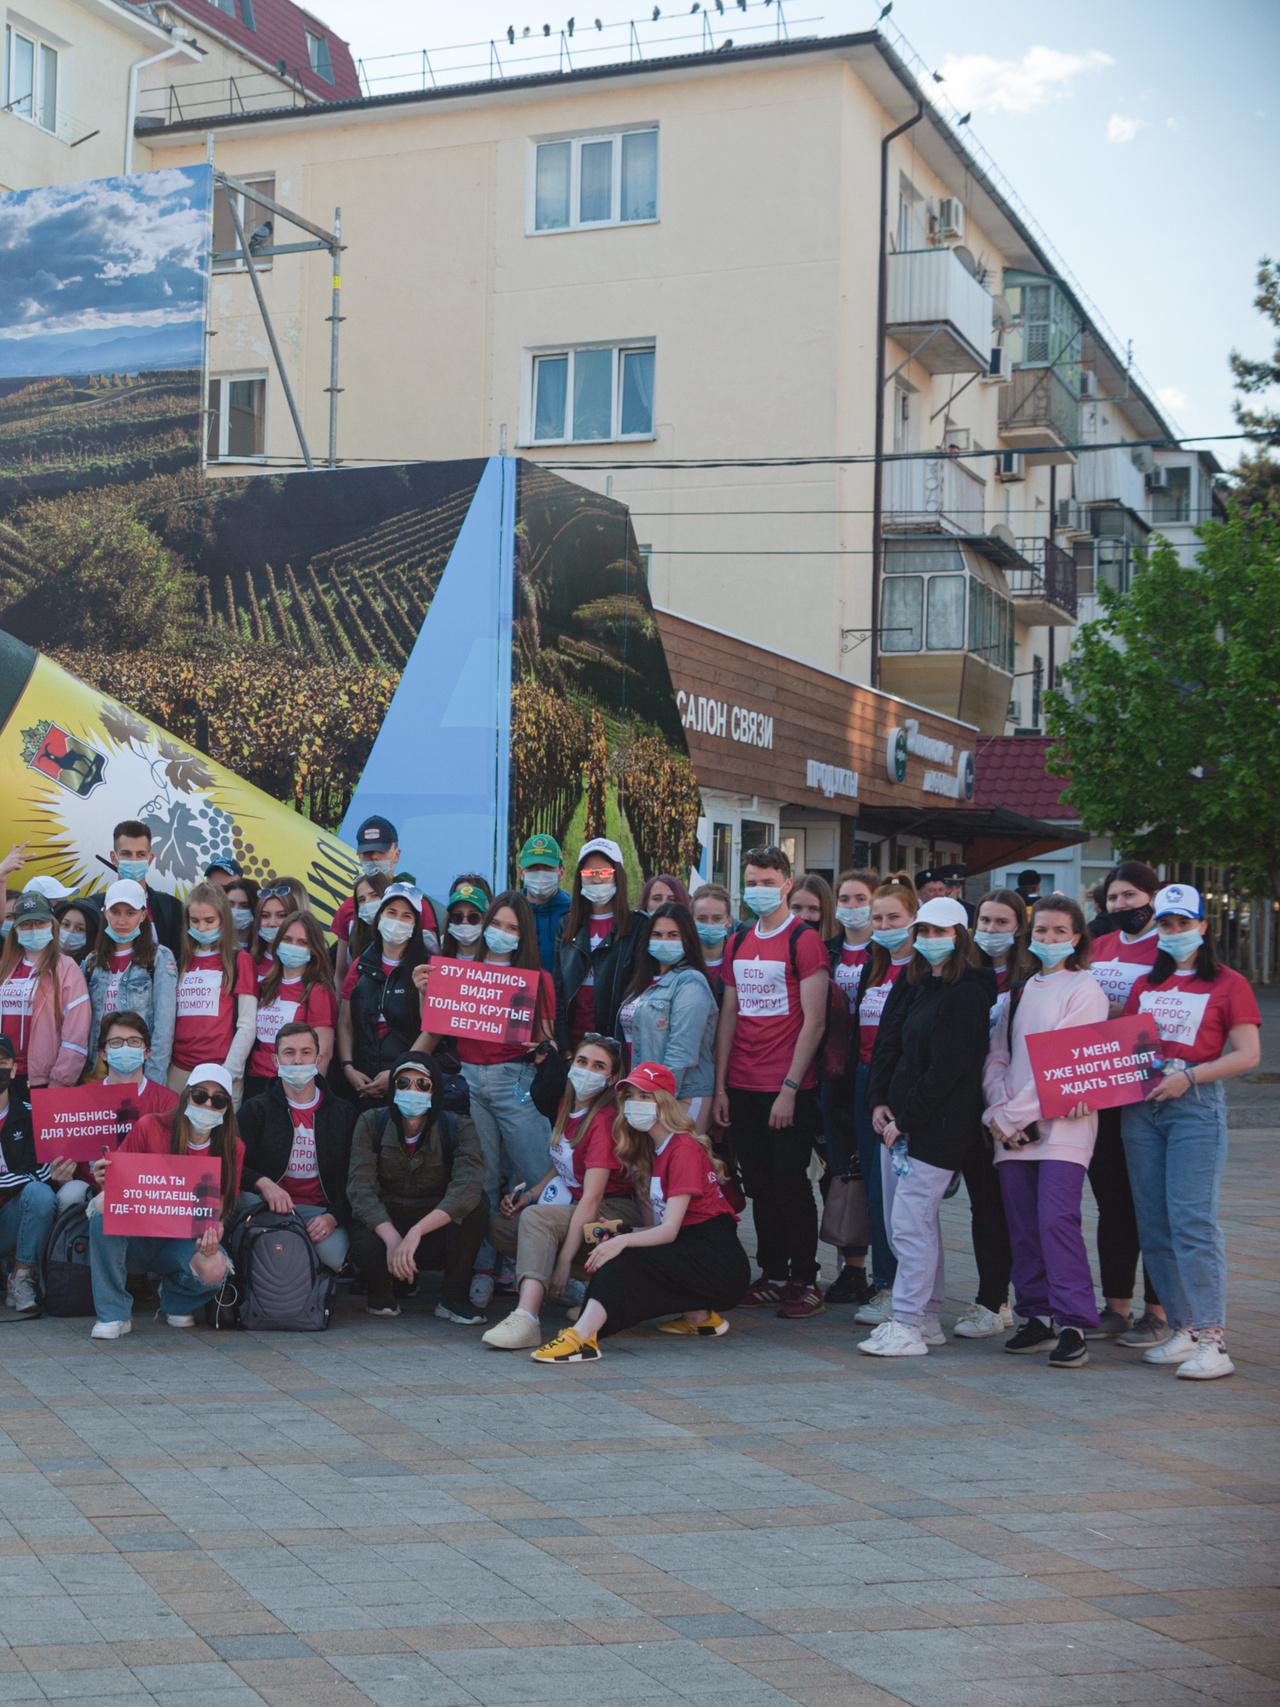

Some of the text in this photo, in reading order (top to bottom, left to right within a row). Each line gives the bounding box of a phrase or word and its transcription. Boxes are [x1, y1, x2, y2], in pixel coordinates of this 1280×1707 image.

[676, 690, 774, 750] САЛОН СВЯЗИ
[806, 759, 859, 798] ПРОДУКТЫ
[440, 965, 527, 988] ЭТУ НАДПИСЬ
[743, 968, 764, 979] ЕСТЬ
[1092, 968, 1123, 977] ЕСТЬ
[183, 976, 204, 985] ЕСТЬ
[459, 984, 504, 1001] ВИДЯТ
[180, 1000, 214, 1009] ПОМОГУ!
[428, 996, 531, 1022] ТОЛЬКО КРУТЫЕ
[1154, 997, 1183, 1006] ЕСТЬ
[256, 1015, 285, 1025] ОПРОС?
[450, 1016, 503, 1035] БЕГУНЫ
[1071, 1041, 1121, 1060] У МЕНЯ
[1043, 1050, 1156, 1081] УЖЕ НОГИ БОЛЯТ
[1060, 1069, 1149, 1096] ЖДАТЬ ТЕБЯ!
[53, 1109, 118, 1124] УЛЫБНИСЬ
[40, 1122, 133, 1140] ДЛЯ УСКОРЕНИЯ
[293, 1135, 315, 1146] СТЬ
[138, 1174, 186, 1186] ПОКА ТЫ
[122, 1189, 200, 1203] ЭТО ЧИТАЕШЬ,
[109, 1203, 213, 1217] ГДЕ-ТО НАЛИВАЮТ!
